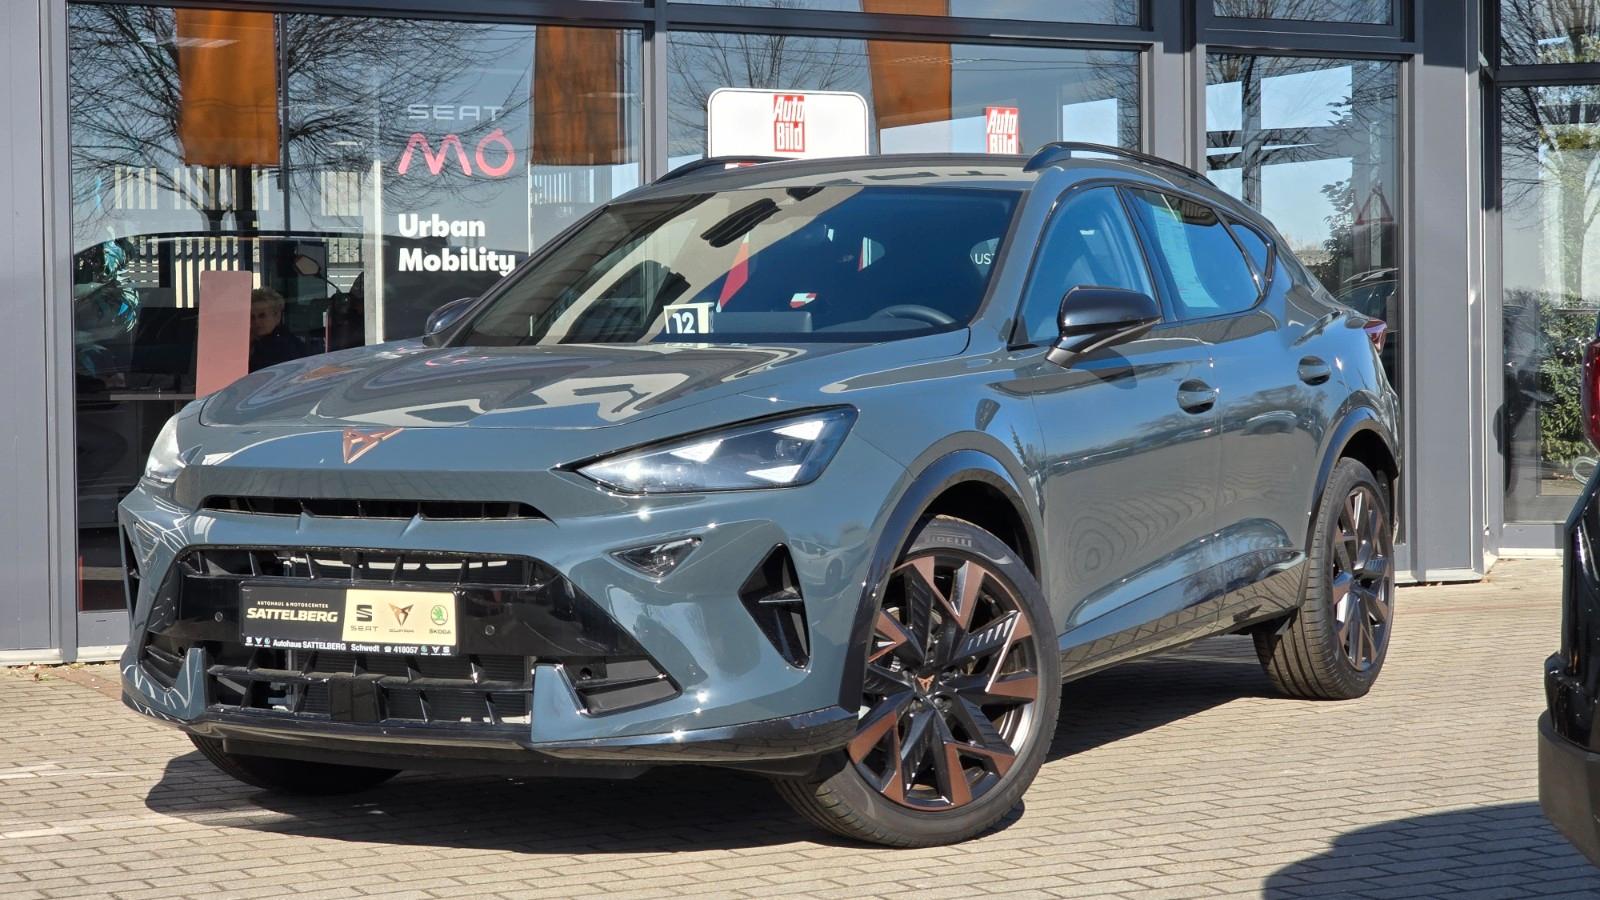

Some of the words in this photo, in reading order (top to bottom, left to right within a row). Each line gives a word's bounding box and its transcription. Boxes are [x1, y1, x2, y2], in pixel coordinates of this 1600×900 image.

[407, 104, 503, 121] SEAT
[774, 96, 805, 122] Auto
[987, 108, 1017, 134] Auto
[776, 122, 804, 151] Bild
[989, 134, 1017, 154] Bild
[398, 214, 486, 237] Urban
[398, 246, 515, 277] Mobility
[672, 312, 696, 334] 12
[246, 607, 338, 623] SATTELBERG
[272, 639, 302, 649] Autohaus
[302, 640, 347, 651] SATTELBERG
[350, 643, 380, 653] Schwedt
